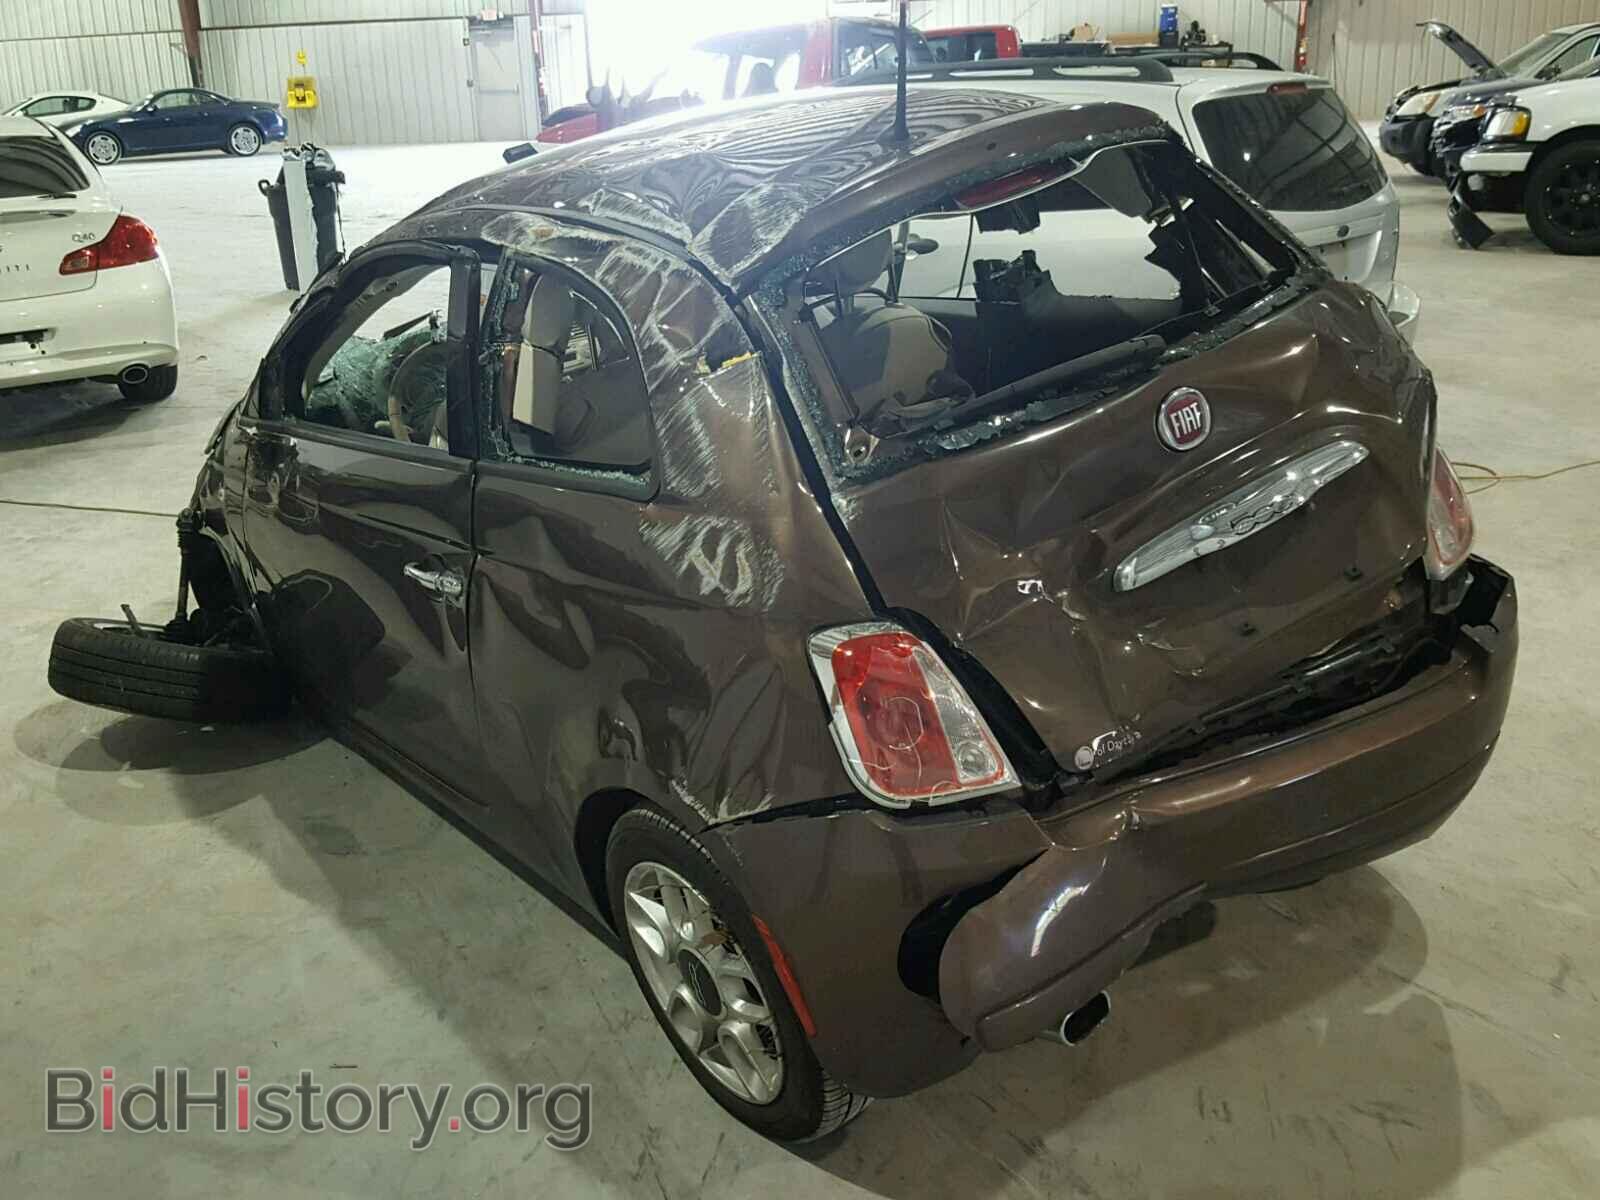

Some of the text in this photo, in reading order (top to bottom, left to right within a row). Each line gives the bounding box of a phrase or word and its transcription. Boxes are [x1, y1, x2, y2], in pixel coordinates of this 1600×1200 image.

[72, 232, 96, 243] Q40
[1170, 402, 1201, 438] FIAT
[1230, 494, 1295, 536] 500
